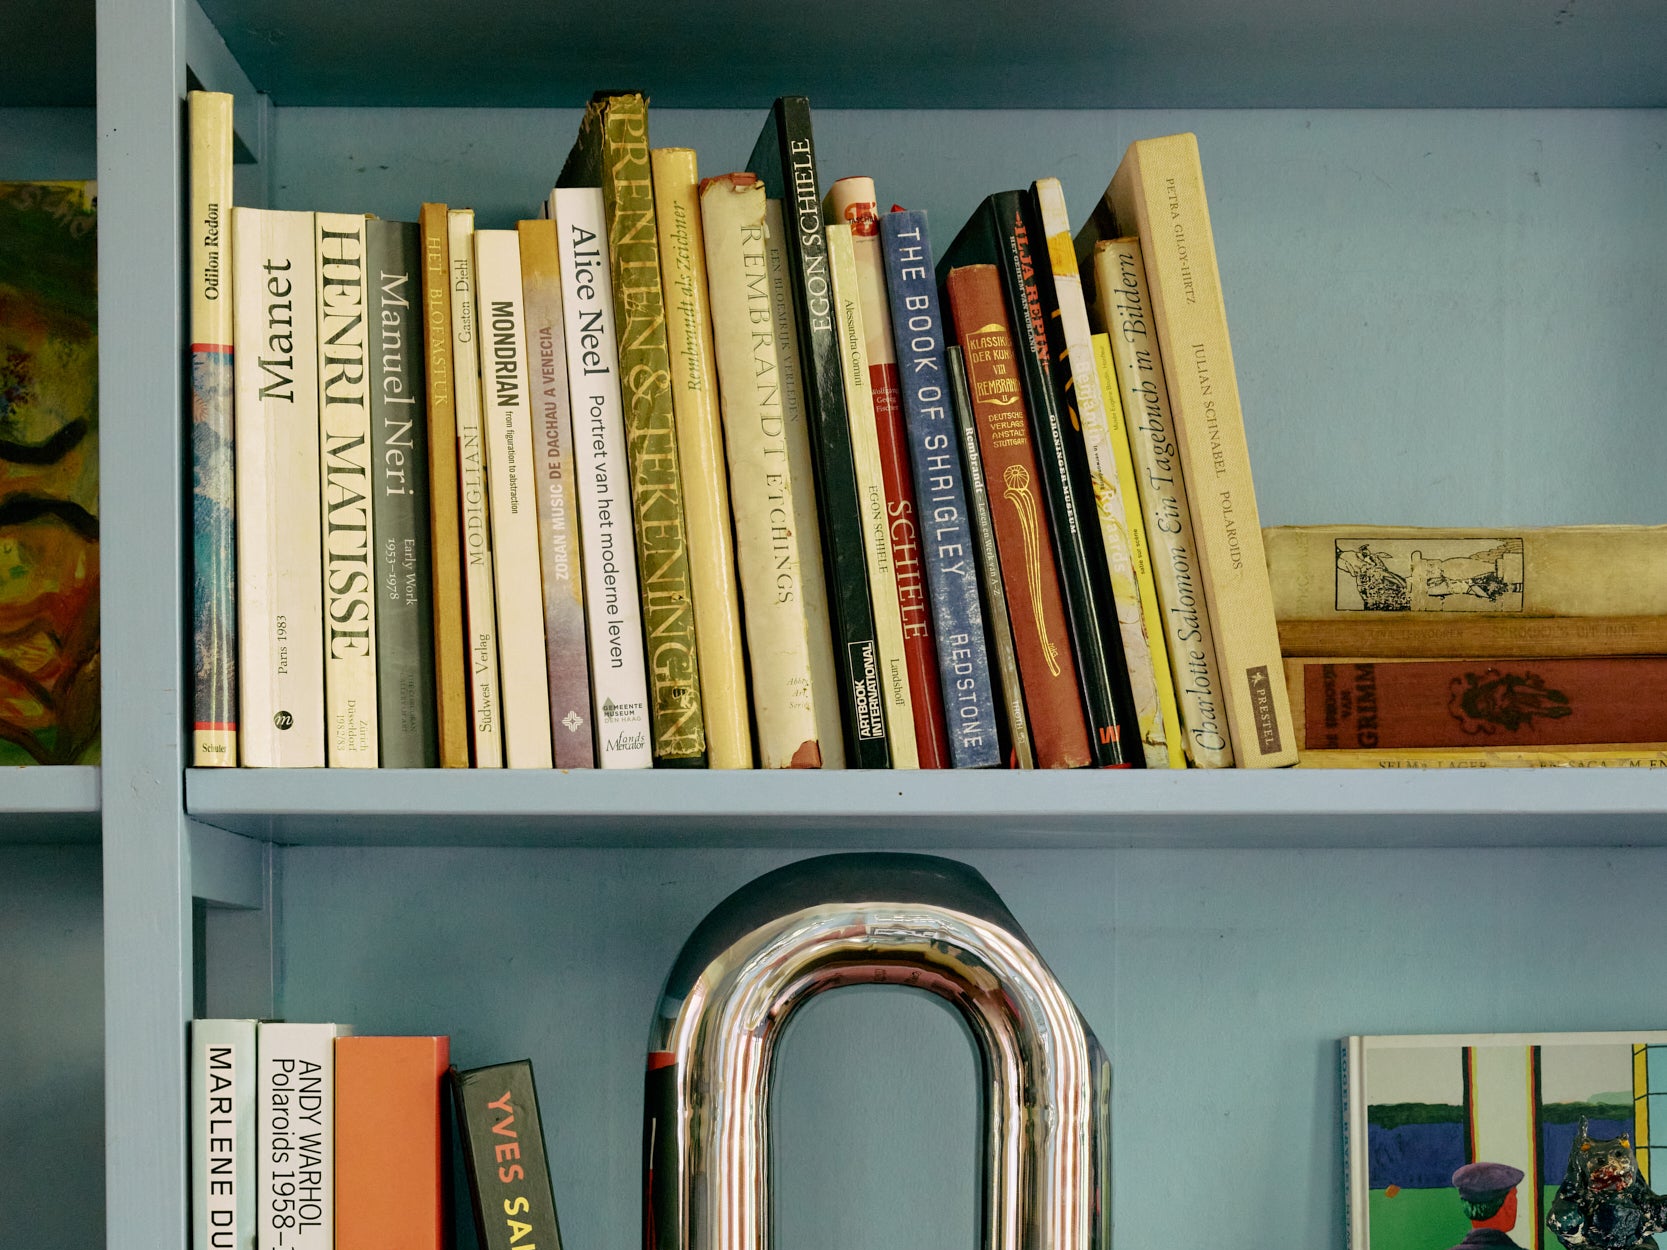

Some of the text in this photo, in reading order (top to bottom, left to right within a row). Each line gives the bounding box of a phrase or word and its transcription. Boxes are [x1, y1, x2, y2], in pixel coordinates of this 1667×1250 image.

[204, 203, 219, 301] Odilon Redon
[427, 236, 442, 275] HET
[790, 137, 833, 334] EGON SCHIELE
[1009, 235, 1037, 354] HET GEHEIM VAN RUSLAND
[1014, 225, 1050, 362] ILJA REPIN
[257, 258, 294, 404] Manet
[380, 269, 417, 497] Manuel Neri
[844, 298, 862, 351] Alessandra
[1165, 177, 1244, 571] PETRA GILOY-HIRTZ JULIAN SCHNABEL POLAROIDS
[320, 226, 371, 661] HENRI MATISSE
[490, 300, 520, 515] MONDRIAN from figuration to abstraction
[538, 325, 569, 581] ZORAN MUSIC DE DACHAU A VENECIA
[571, 224, 624, 669] Alice Neel Portret van het moderne leven
[739, 224, 794, 605] REMBRANDT ETCHINGS
[990, 420, 1025, 431] VERLAGS
[453, 259, 492, 734] Gaston Diehl MODIGLIANI Südwest Verlag
[868, 484, 882, 520] EGON
[897, 226, 983, 750] THE BOOK OF SHRIGLEY REDSTONE
[1049, 414, 1078, 534] GRONINGER MUSEUM
[1112, 252, 1227, 751] Charlotte Salomon Ein Tagebuch in Bildern
[402, 538, 419, 607] Early Work
[873, 520, 889, 574] SCHIELE
[887, 498, 929, 641] SCHIELE
[276, 614, 289, 676] Paris 1983
[863, 641, 883, 737] INTERNATIONAL
[889, 658, 906, 707] Landshoff
[602, 703, 643, 712] GEMEENTE
[603, 710, 636, 718] MUSEUM
[855, 678, 872, 738] ARTBOOK
[1256, 688, 1273, 747] PRESTEL
[208, 1047, 234, 1196] MARLENE
[271, 1058, 296, 1164] Polaroids
[298, 1059, 322, 1236] ANDY WARHOL
[486, 1090, 526, 1184] YVES
